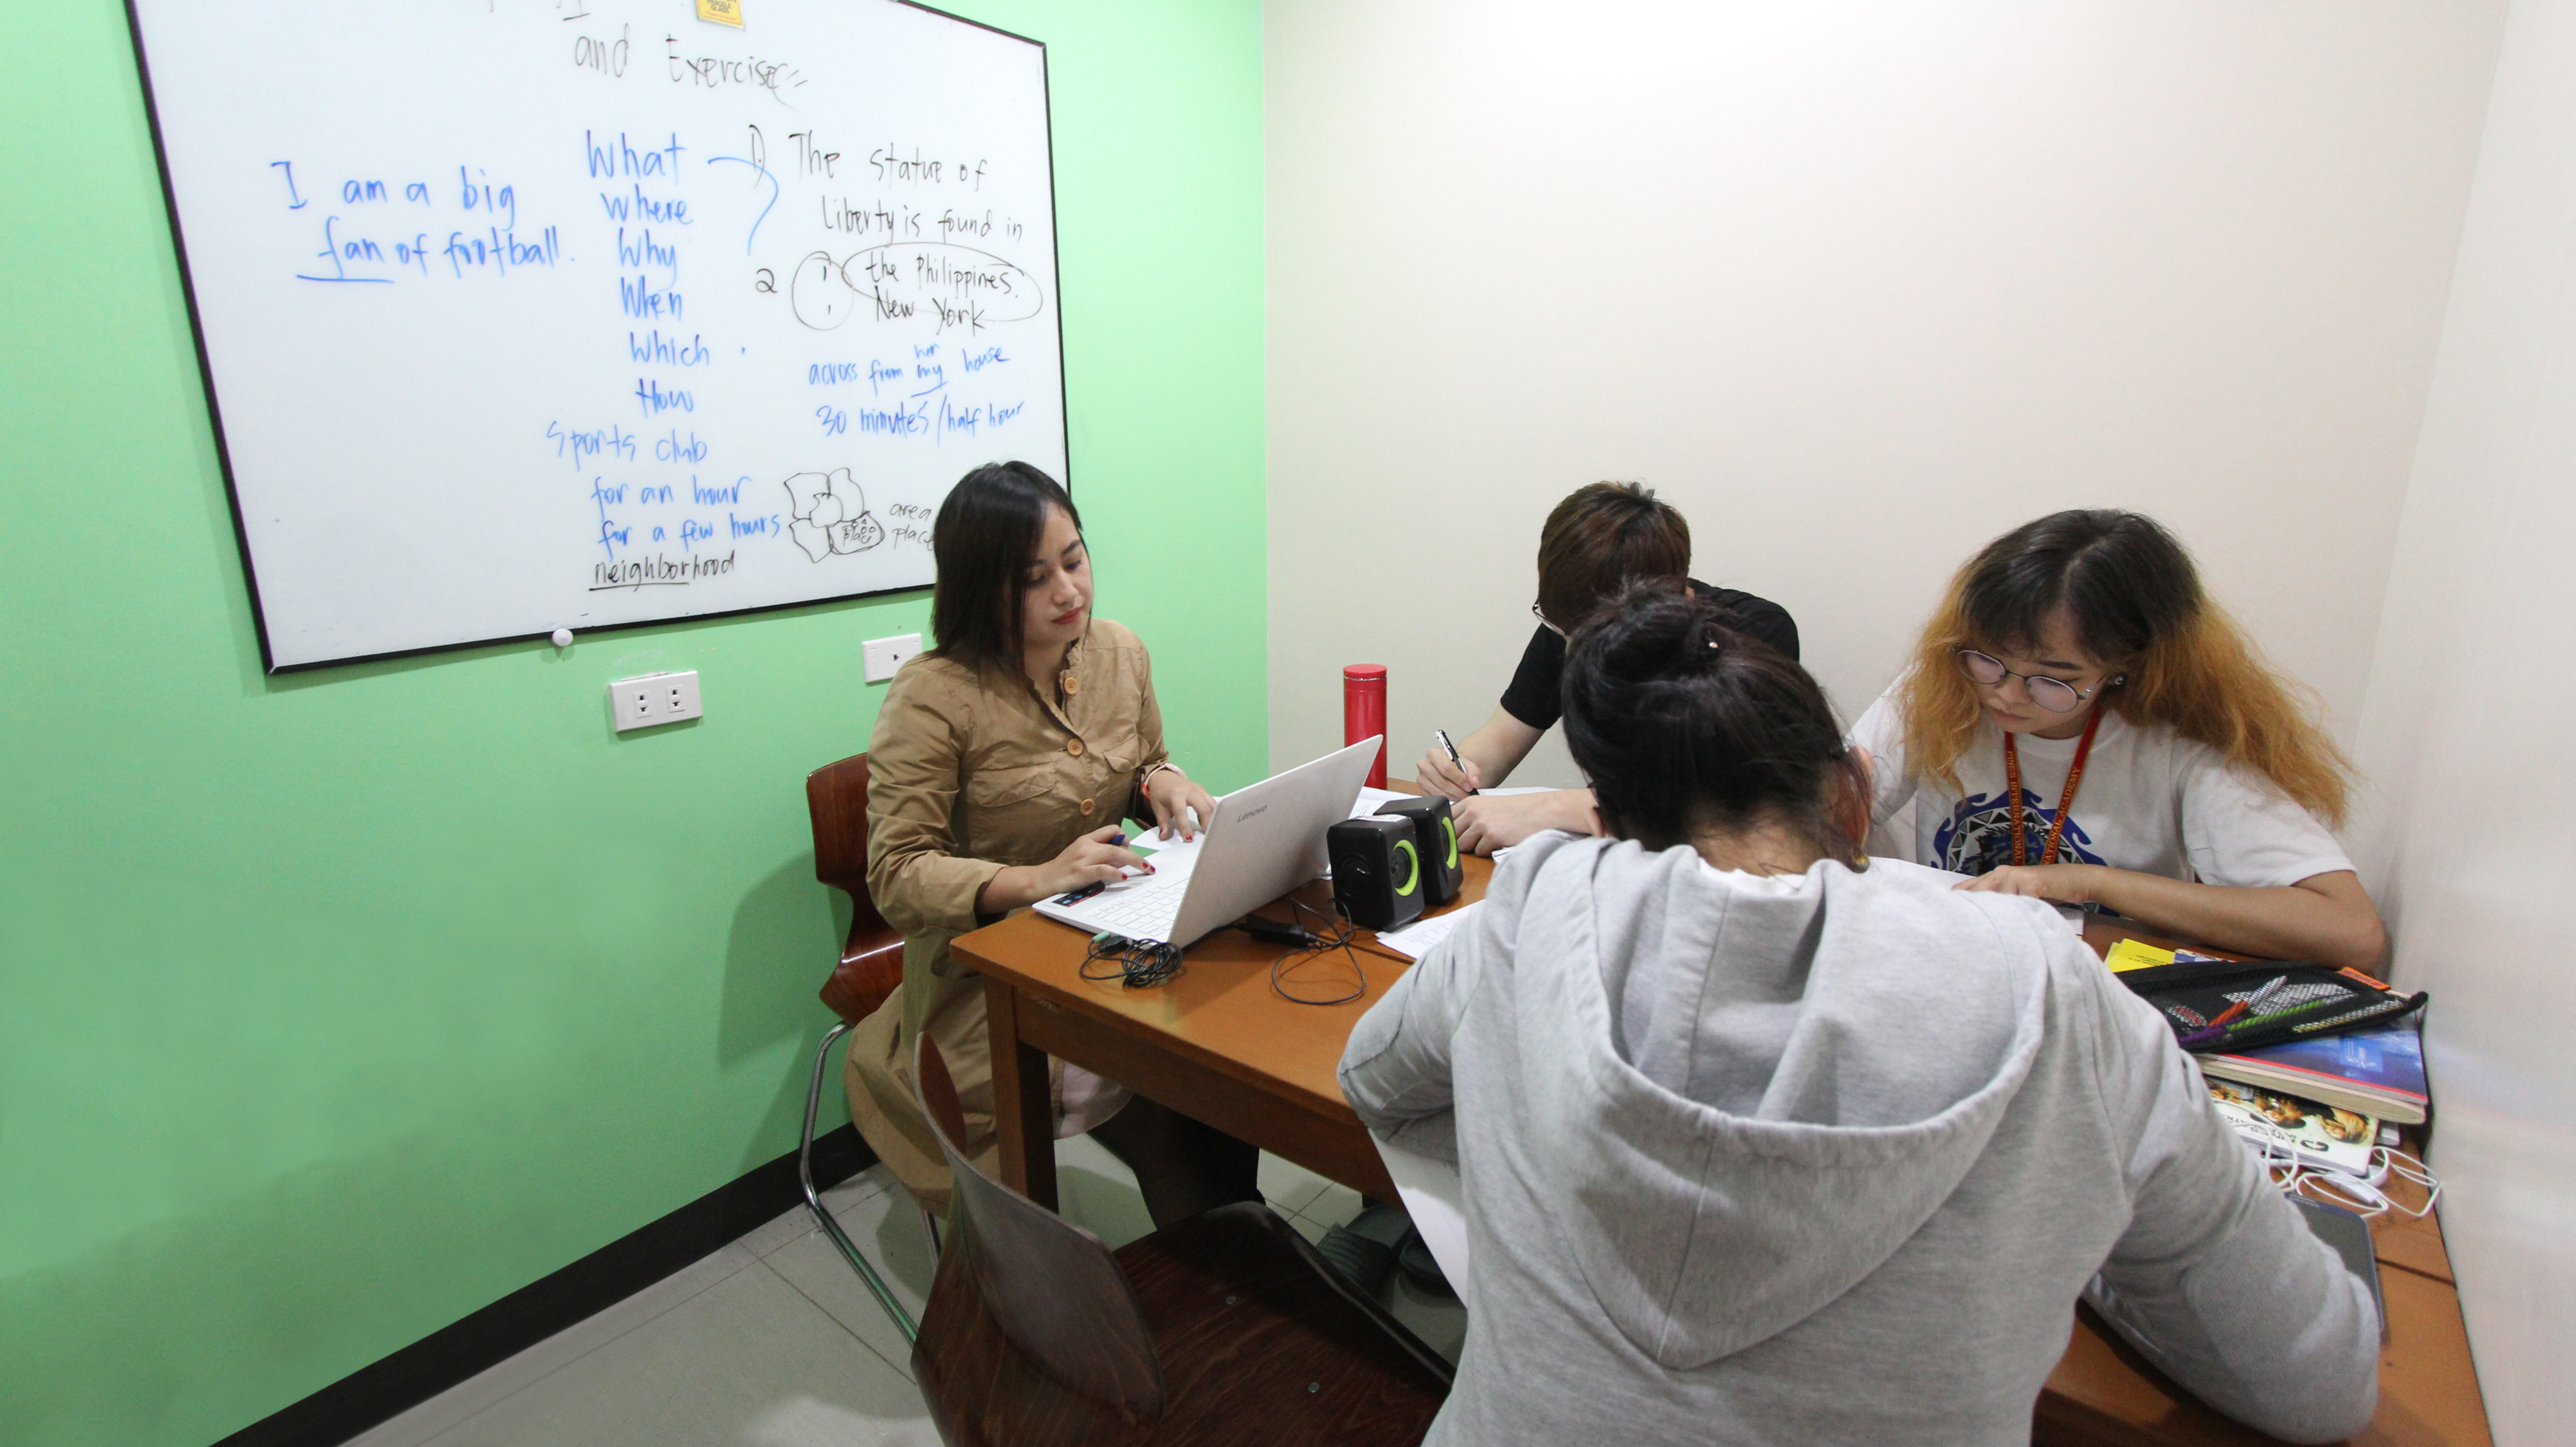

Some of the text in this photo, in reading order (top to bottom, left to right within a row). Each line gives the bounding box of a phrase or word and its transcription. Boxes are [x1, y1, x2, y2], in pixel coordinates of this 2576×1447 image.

[575, 23, 629, 77] and
[587, 130, 687, 185] What
[789, 131, 840, 180] The
[959, 159, 987, 191] of
[270, 161, 515, 231] I am a big
[318, 216, 385, 279] fan
[397, 234, 428, 276] of
[938, 210, 992, 244] found
[1007, 218, 1023, 242] in
[619, 227, 676, 291] Why
[756, 268, 779, 293] 2
[866, 250, 899, 282] the
[621, 275, 682, 321] When
[875, 286, 986, 336] New York
[630, 330, 710, 366] Which
[809, 347, 1010, 398] across from my house
[635, 378, 694, 419] How
[816, 405, 847, 436] 30
[989, 401, 1025, 427] hour
[656, 428, 707, 463] club
[590, 475, 752, 521] for an hour
[890, 503, 932, 521] area
[598, 512, 780, 563] for a few hours
[596, 549, 735, 592] neighborhood
[1237, 804, 1268, 823] Lenovo
[2058, 766, 2081, 818] ACADEMY
[2011, 782, 2022, 859] INTERNATIONAL
